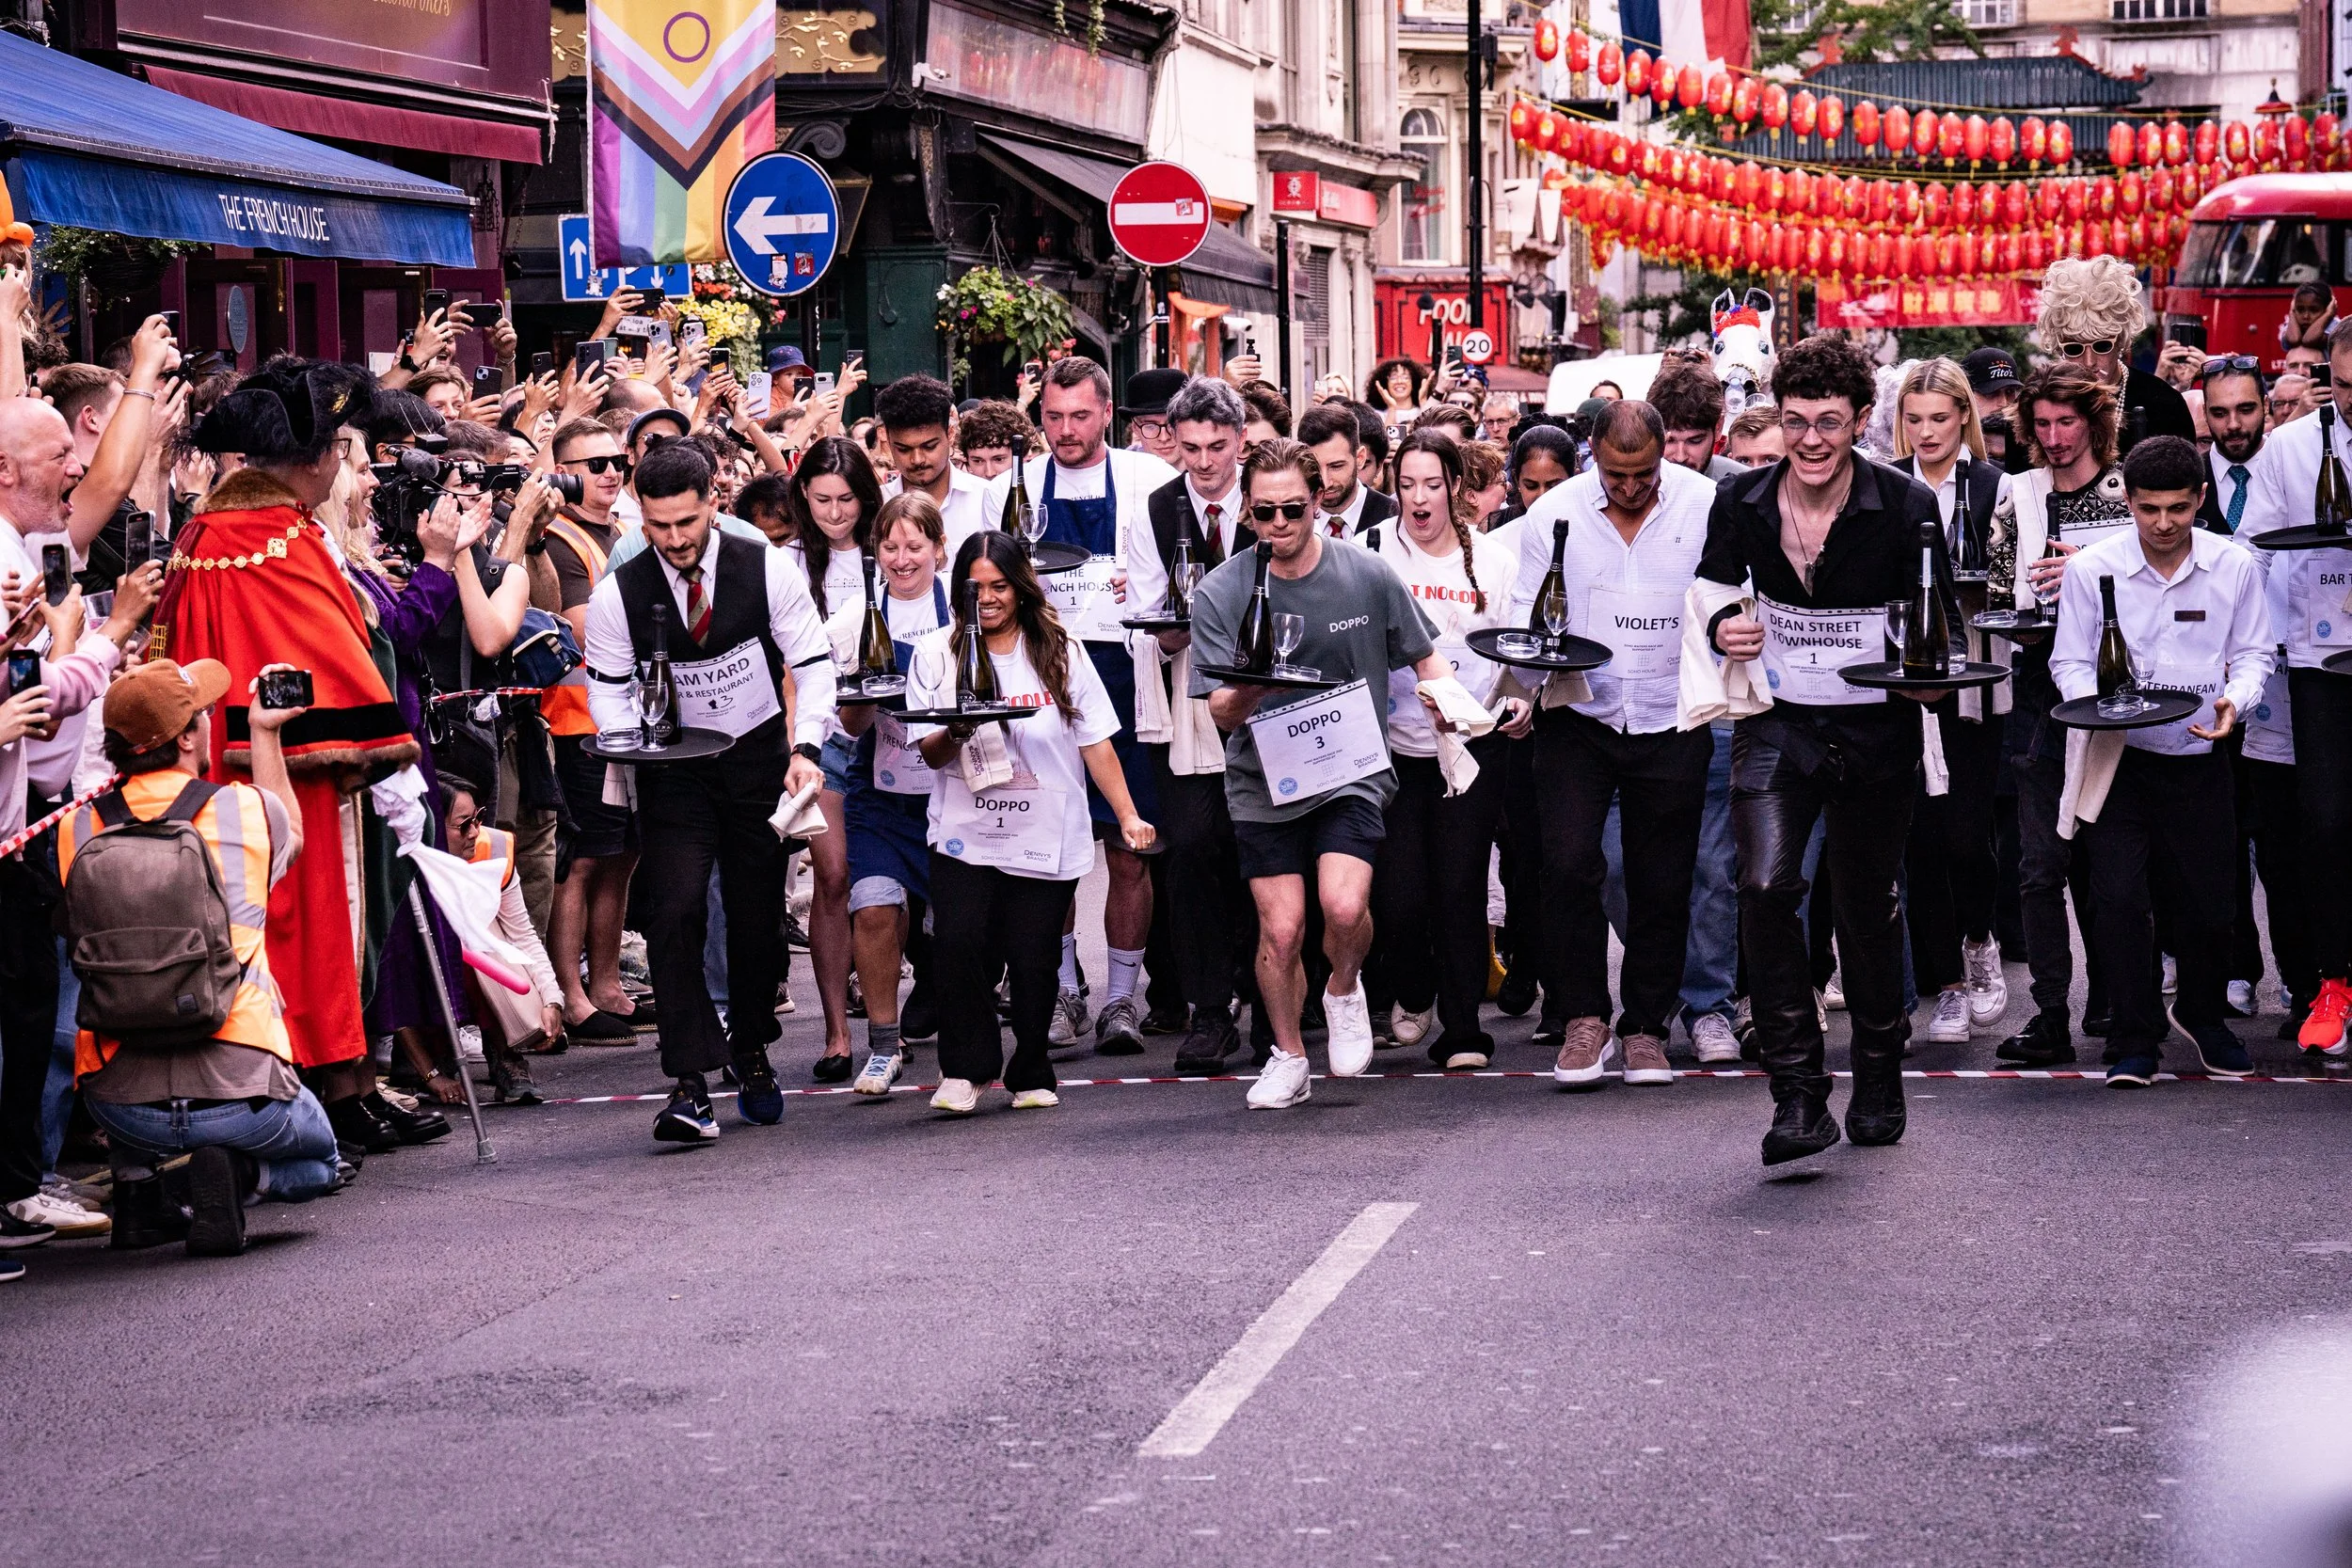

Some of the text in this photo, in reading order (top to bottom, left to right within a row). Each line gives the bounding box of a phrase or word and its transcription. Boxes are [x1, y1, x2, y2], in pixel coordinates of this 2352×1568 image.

[218, 194, 329, 241] THE FRENCH HOUSE
[1466, 340, 1490, 354] 20
[1063, 568, 1085, 578] THE
[2319, 573, 2345, 586] BAR
[1078, 581, 1114, 593] HOUS
[1070, 595, 1077, 606] 1
[1328, 614, 1370, 633] DOPPO
[1614, 615, 1679, 630] VIOLET'S
[1770, 613, 1863, 633] DEAN STREET
[898, 627, 926, 641] RENCH
[1771, 628, 1864, 649] TOWNHOUSE
[1809, 652, 1819, 665] 1
[675, 657, 751, 688] AM YARD
[685, 690, 694, 699] &
[695, 672, 755, 698] RESTAURANT
[721, 694, 734, 708] 3
[1287, 710, 1343, 738] DOPPO
[882, 734, 913, 752] FRENC
[1314, 736, 1326, 749] 3
[915, 754, 925, 765] 2
[1353, 752, 1379, 767] DENNYS
[975, 796, 1030, 813] DOPPO
[996, 816, 1005, 829] 1
[1024, 849, 1052, 859] DENNYS
